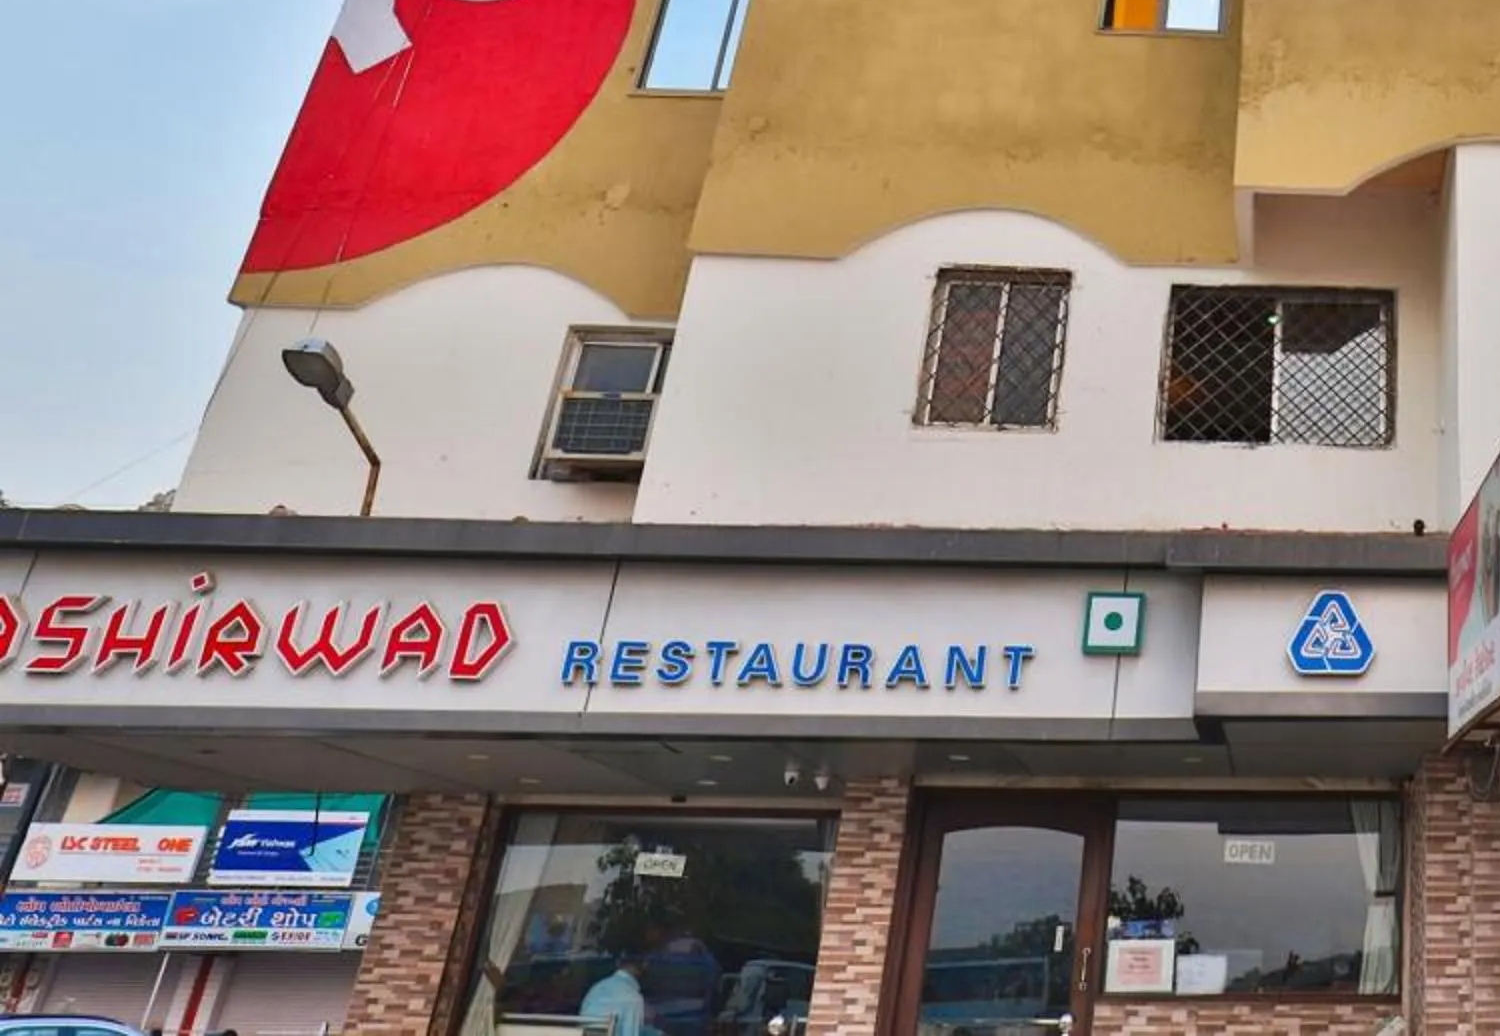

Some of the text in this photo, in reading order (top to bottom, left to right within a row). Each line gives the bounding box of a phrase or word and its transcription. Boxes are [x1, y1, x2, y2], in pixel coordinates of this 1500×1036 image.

[561, 640, 1036, 691] RESTAURANT
[1228, 844, 1272, 860] OPEN
[643, 859, 679, 872] OPEN
